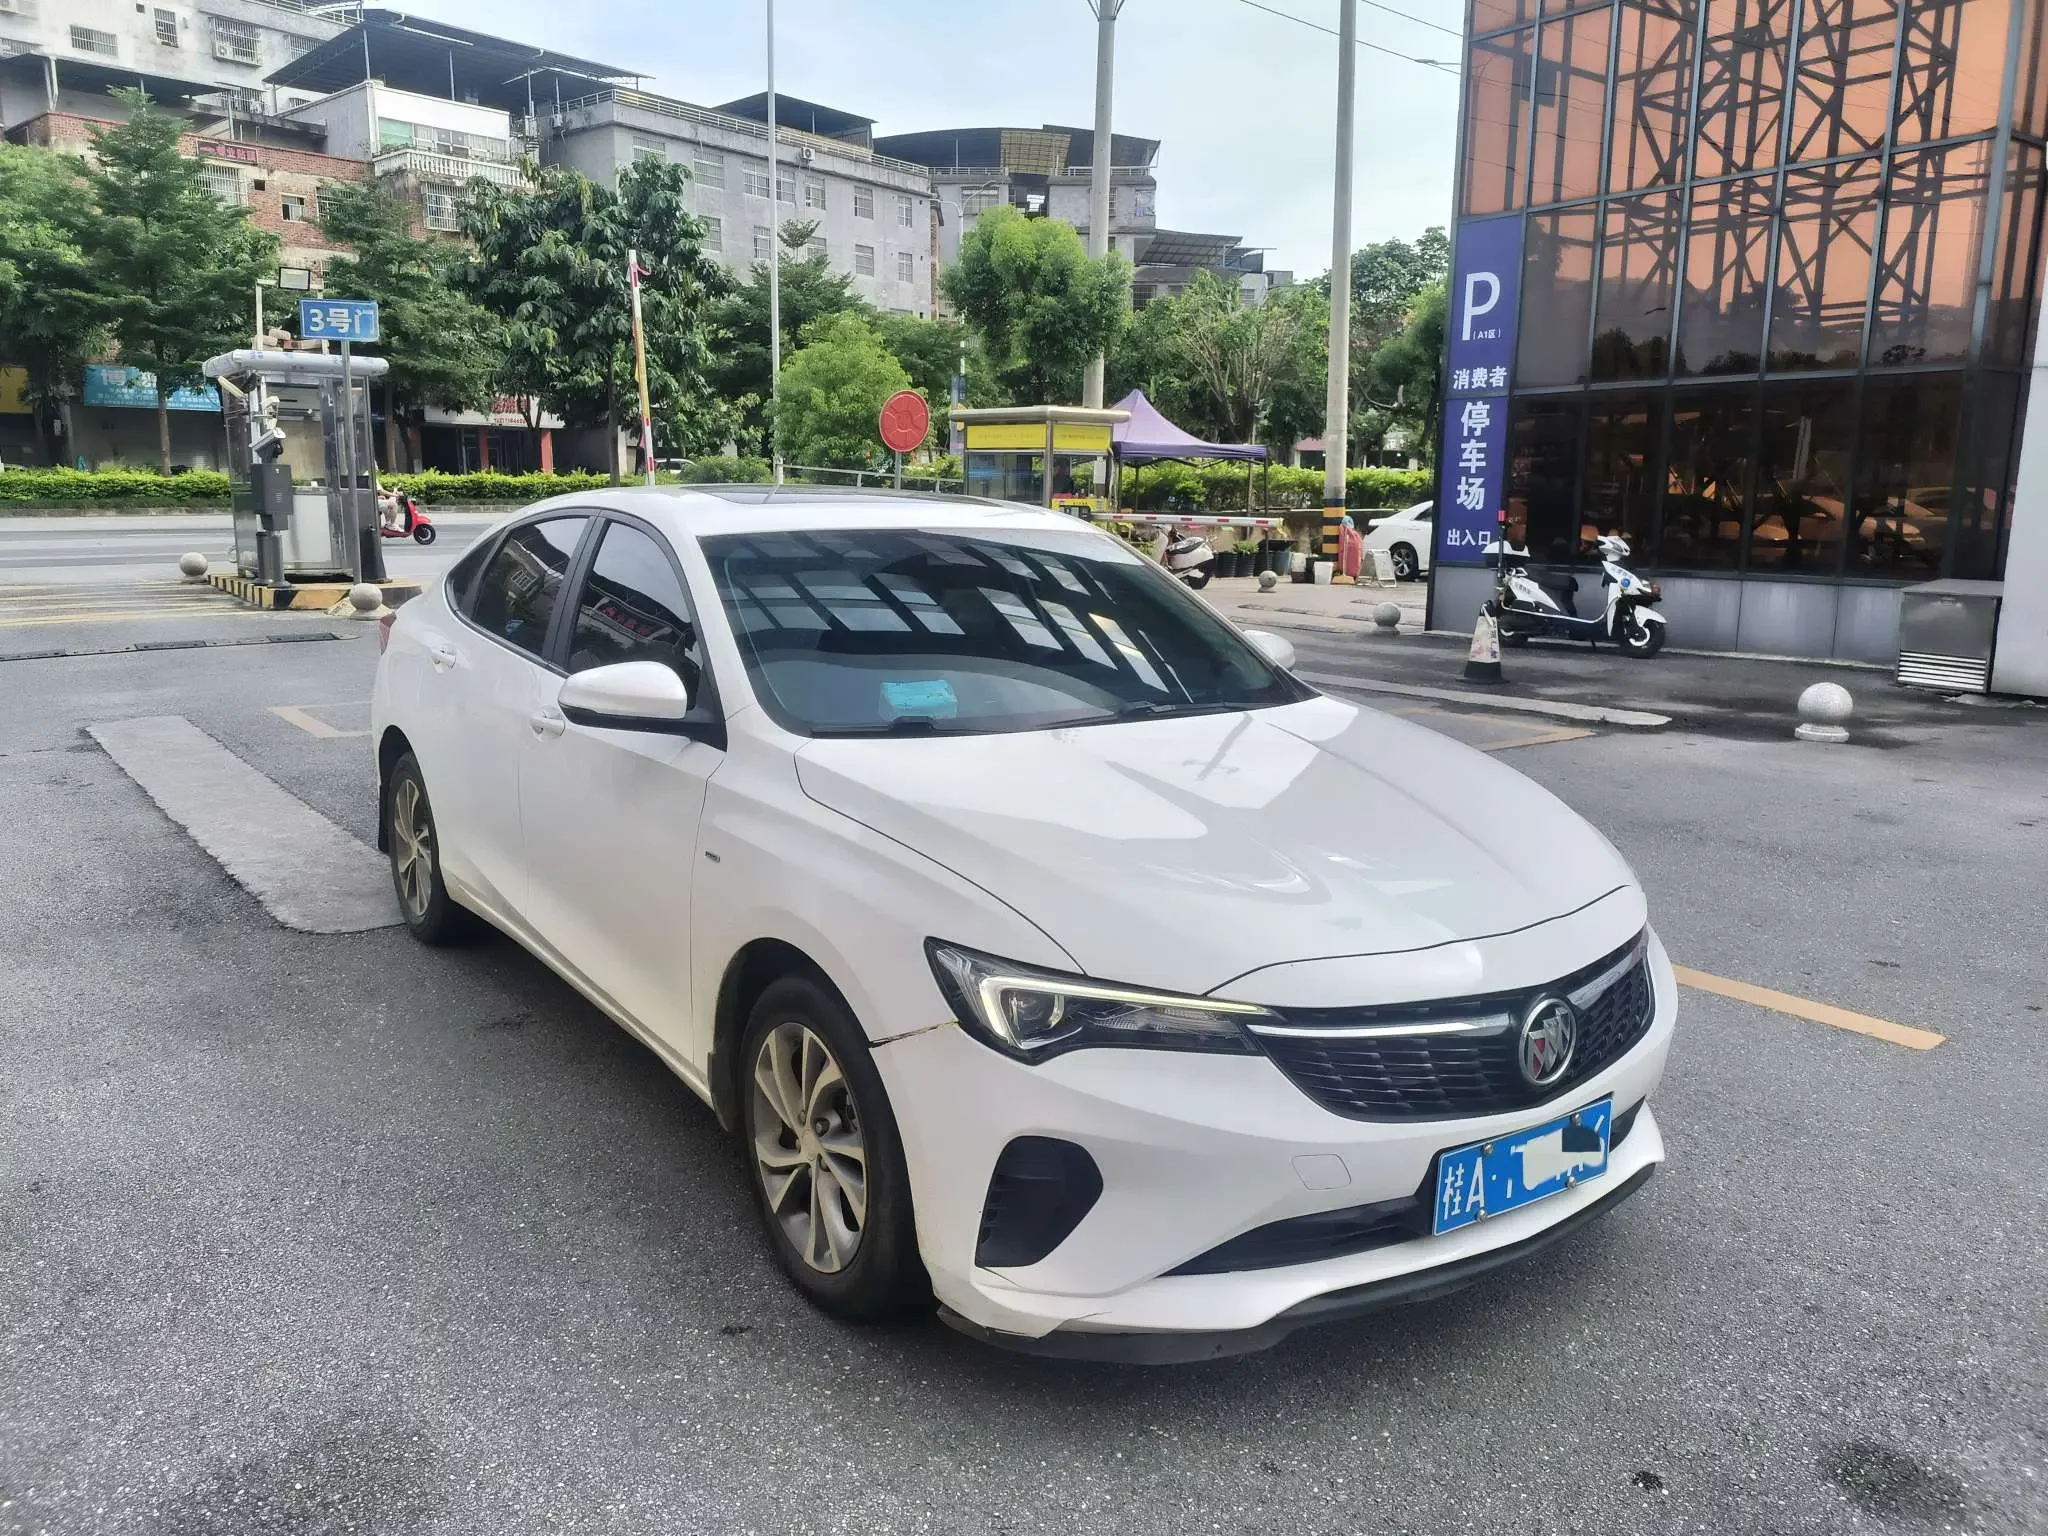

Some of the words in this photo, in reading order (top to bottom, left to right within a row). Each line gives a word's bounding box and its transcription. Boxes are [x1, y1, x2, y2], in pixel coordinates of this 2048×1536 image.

[1462, 271, 1500, 341] P
[309, 308, 375, 334] 3号门
[1453, 365, 1507, 390] 消费者
[1456, 401, 1490, 511] 停车场
[1447, 528, 1491, 546] 出入口
